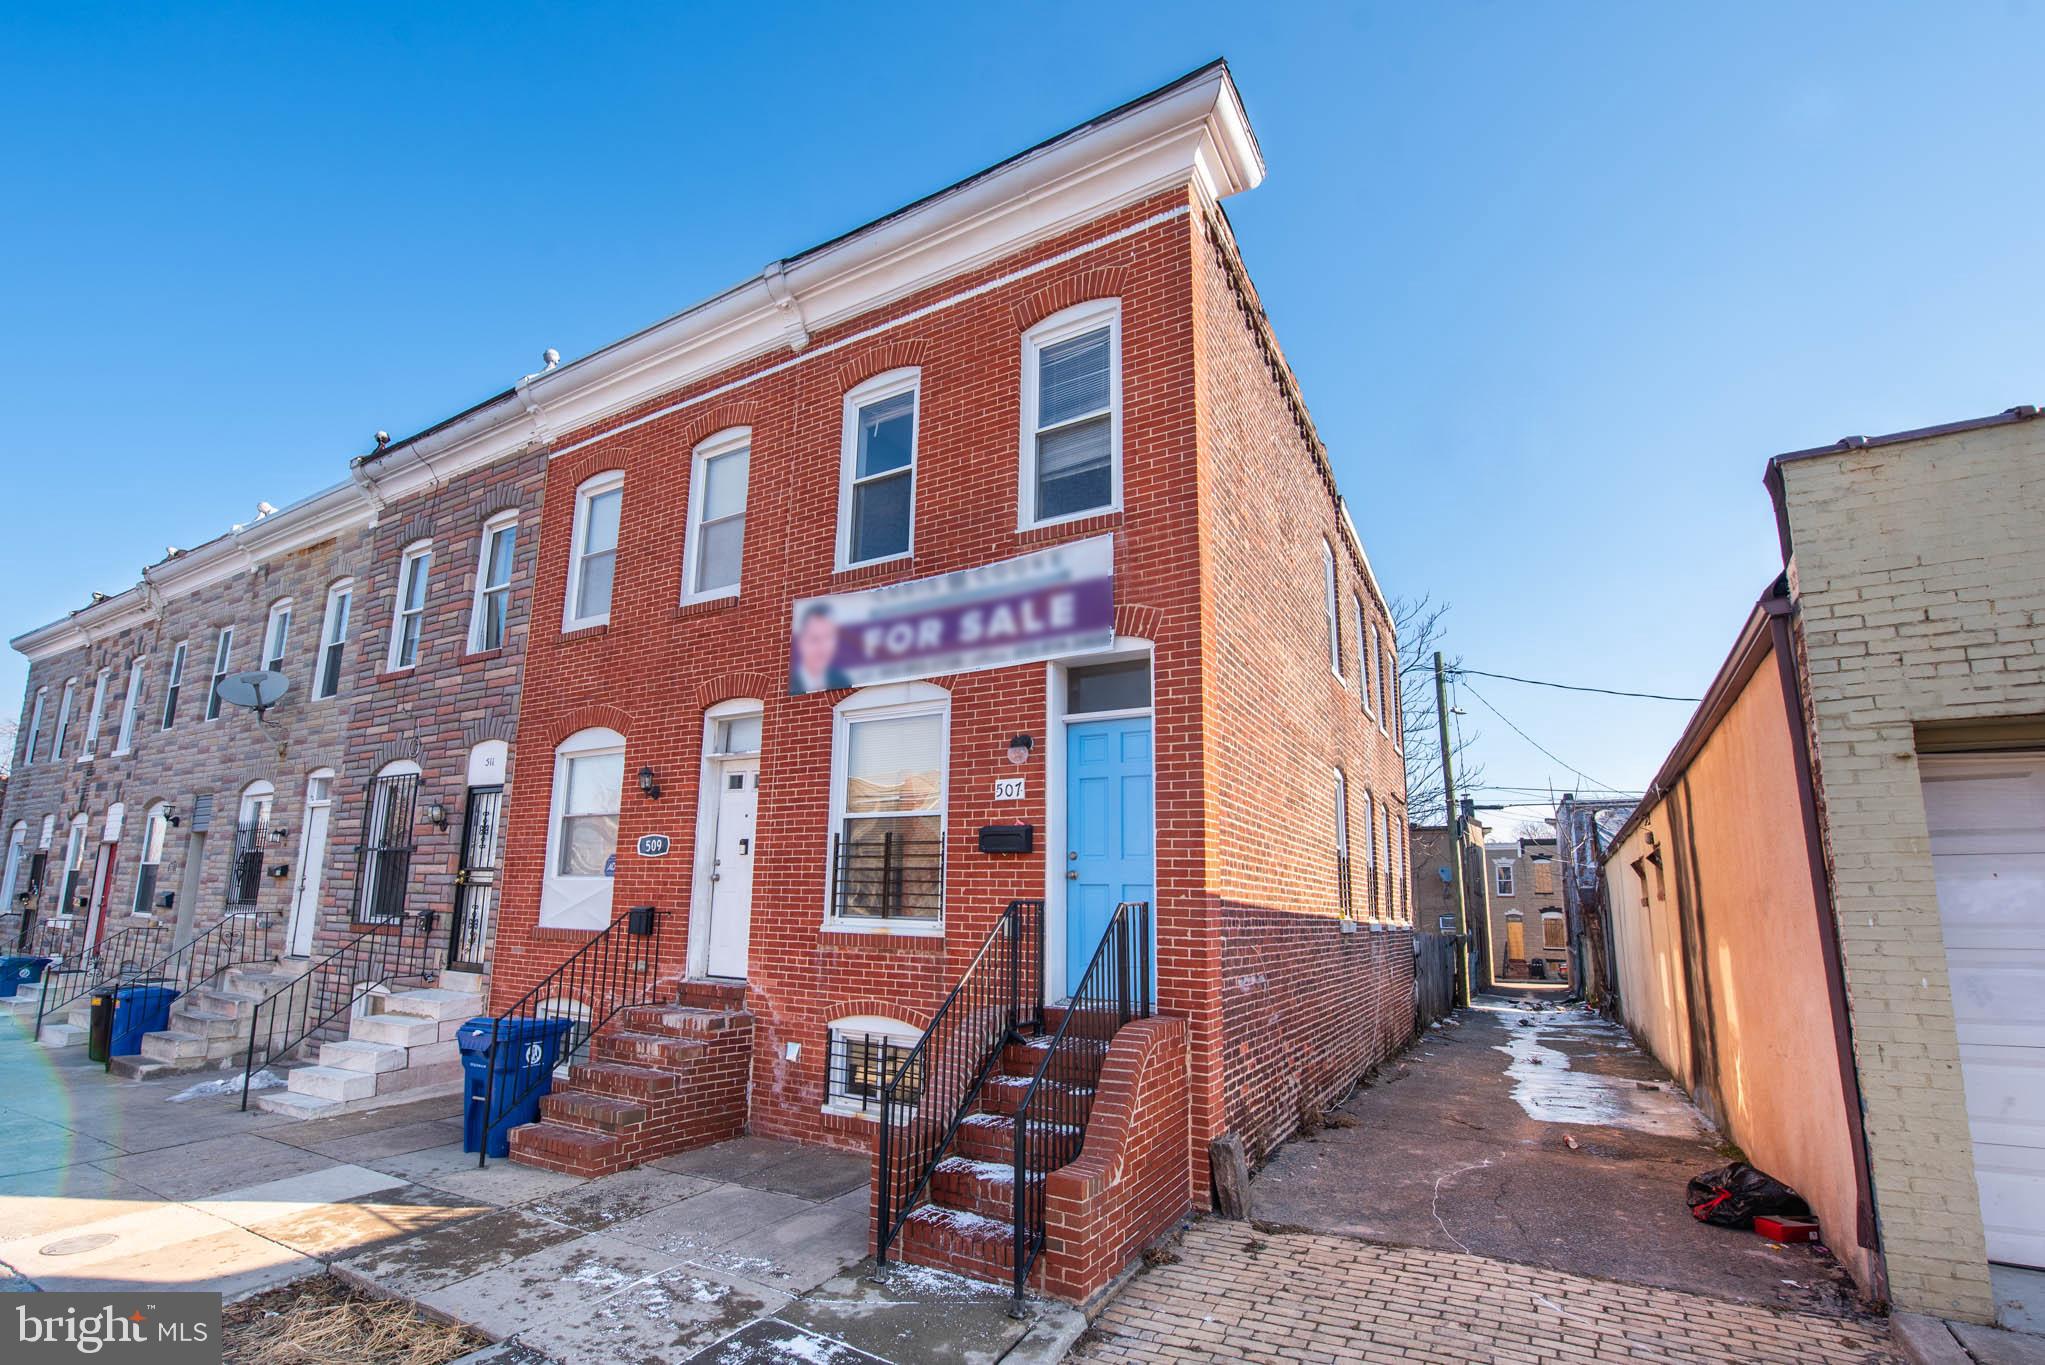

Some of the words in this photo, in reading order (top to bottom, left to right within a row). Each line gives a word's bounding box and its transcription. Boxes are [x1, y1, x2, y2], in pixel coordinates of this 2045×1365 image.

[863, 616, 946, 660] FOR
[959, 592, 1078, 642] SALE
[996, 782, 1022, 798] 507
[645, 839, 663, 852] 509
